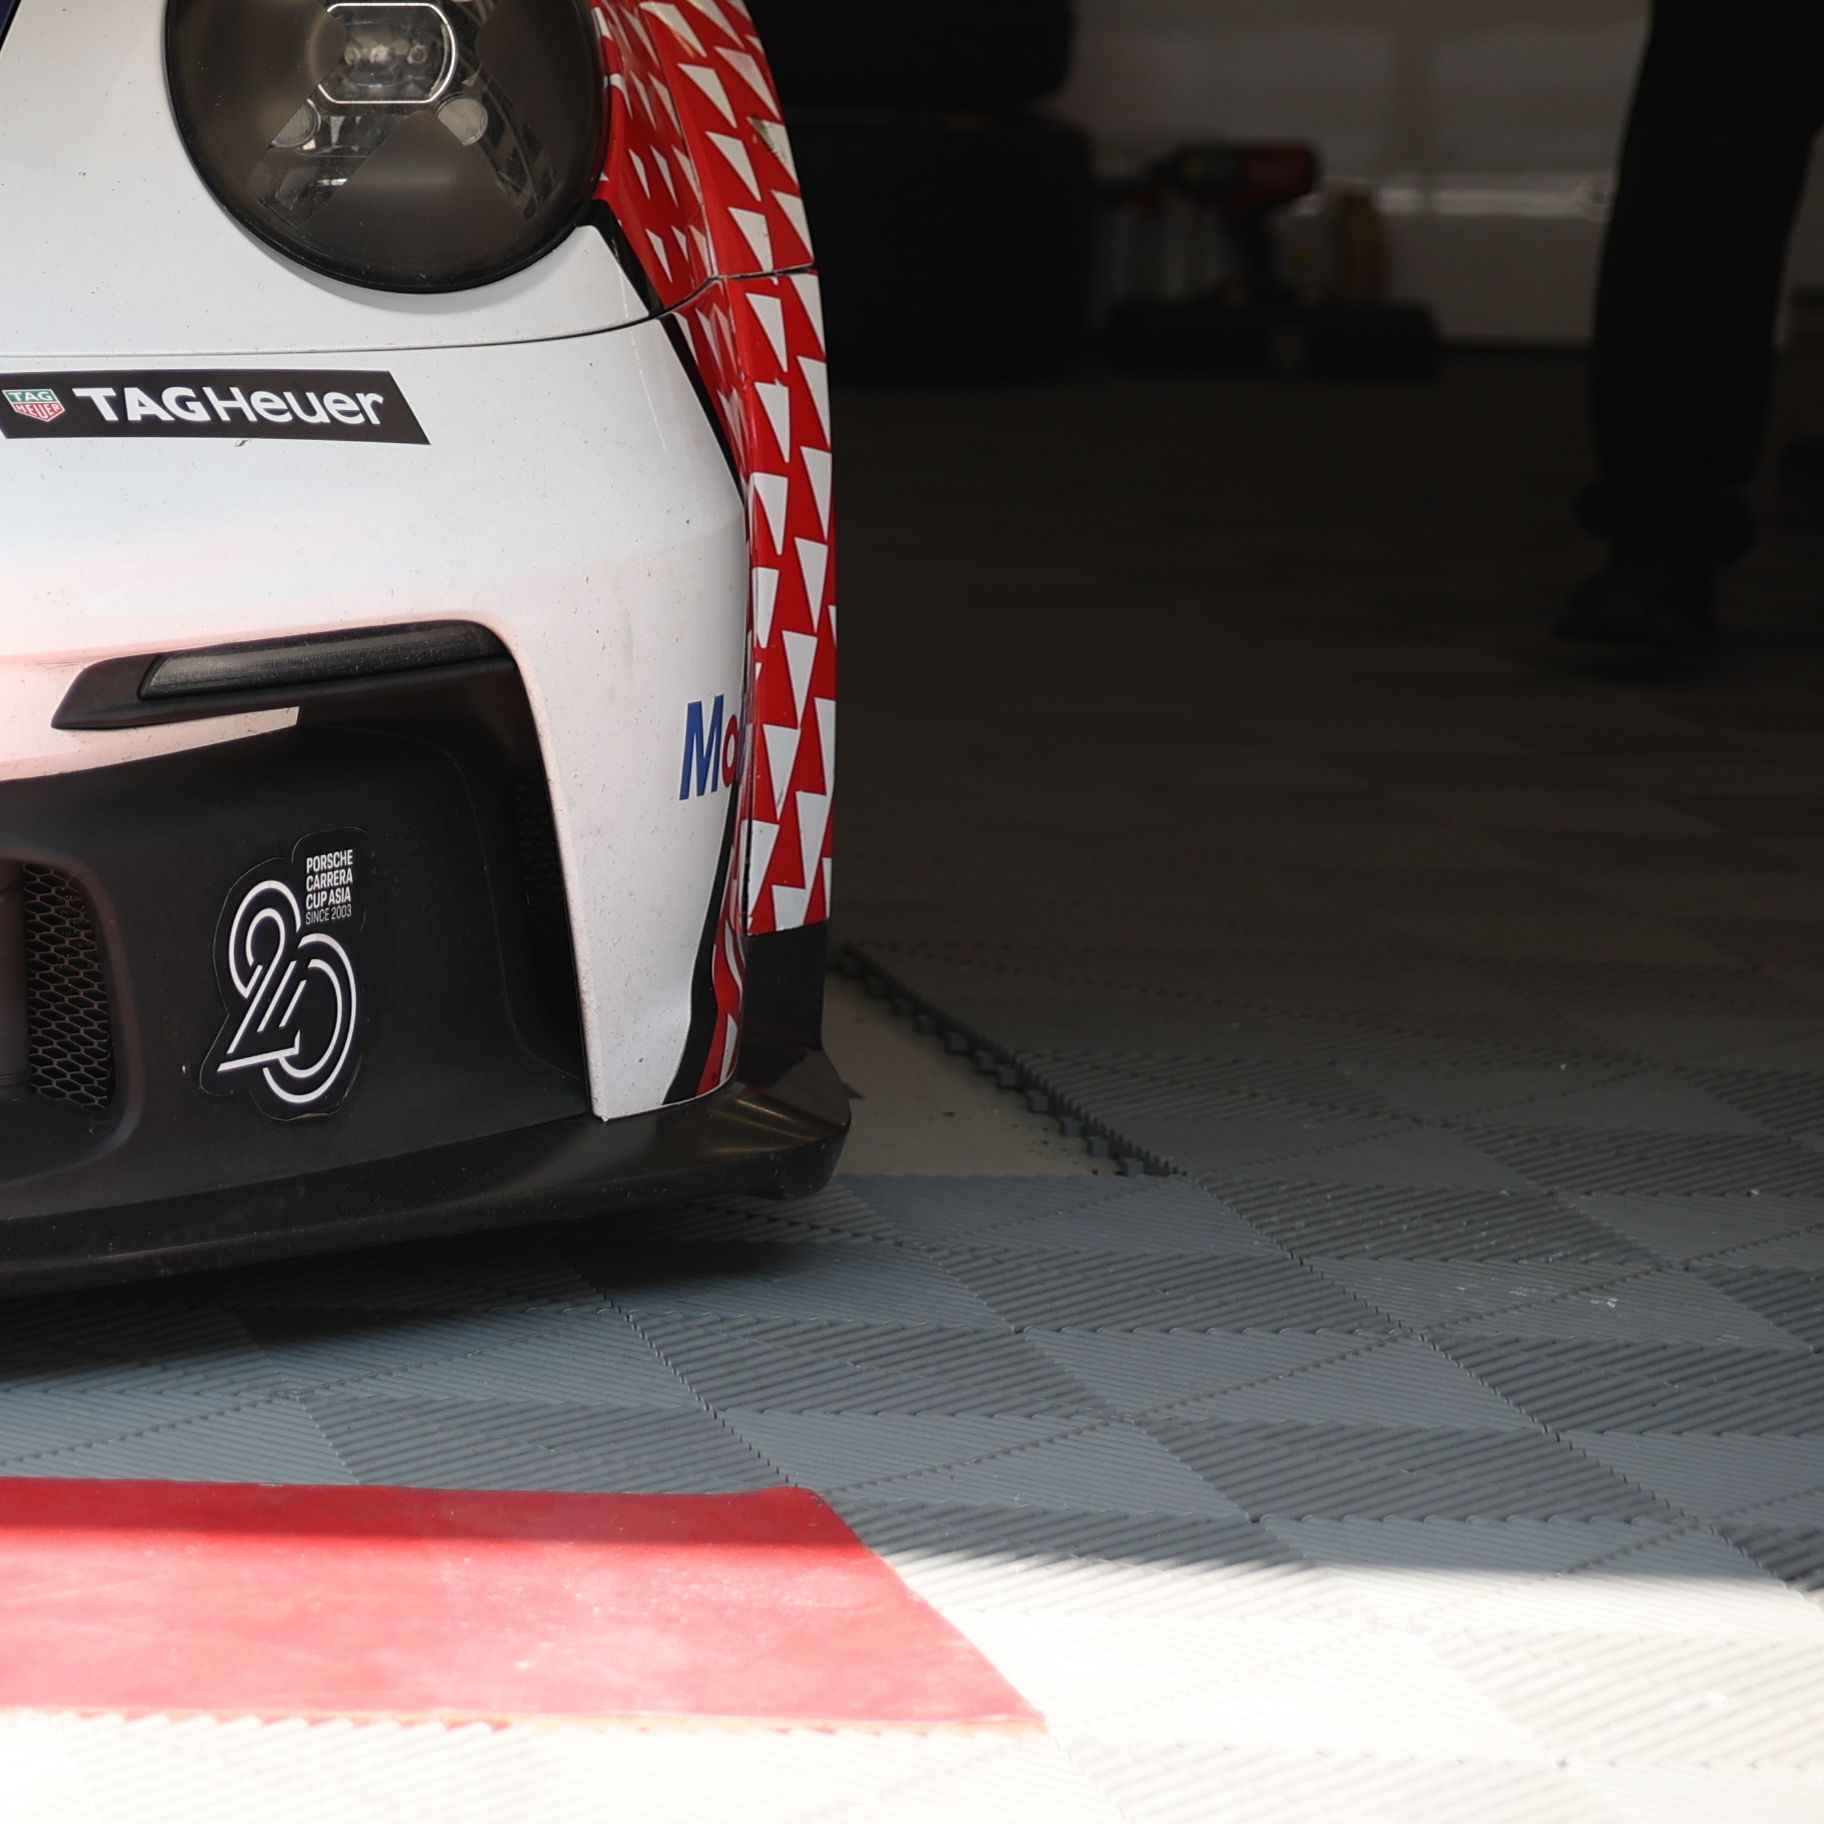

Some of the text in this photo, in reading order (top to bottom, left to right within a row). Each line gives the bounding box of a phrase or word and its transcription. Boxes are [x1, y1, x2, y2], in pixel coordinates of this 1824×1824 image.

[7, 390, 54, 402] TAG
[14, 403, 62, 421] HEUER
[306, 849, 353, 874] PORSCHE
[306, 867, 353, 892] CARRERA
[305, 886, 351, 910] CUP ASIA
[305, 904, 352, 925] SINCE 2003
